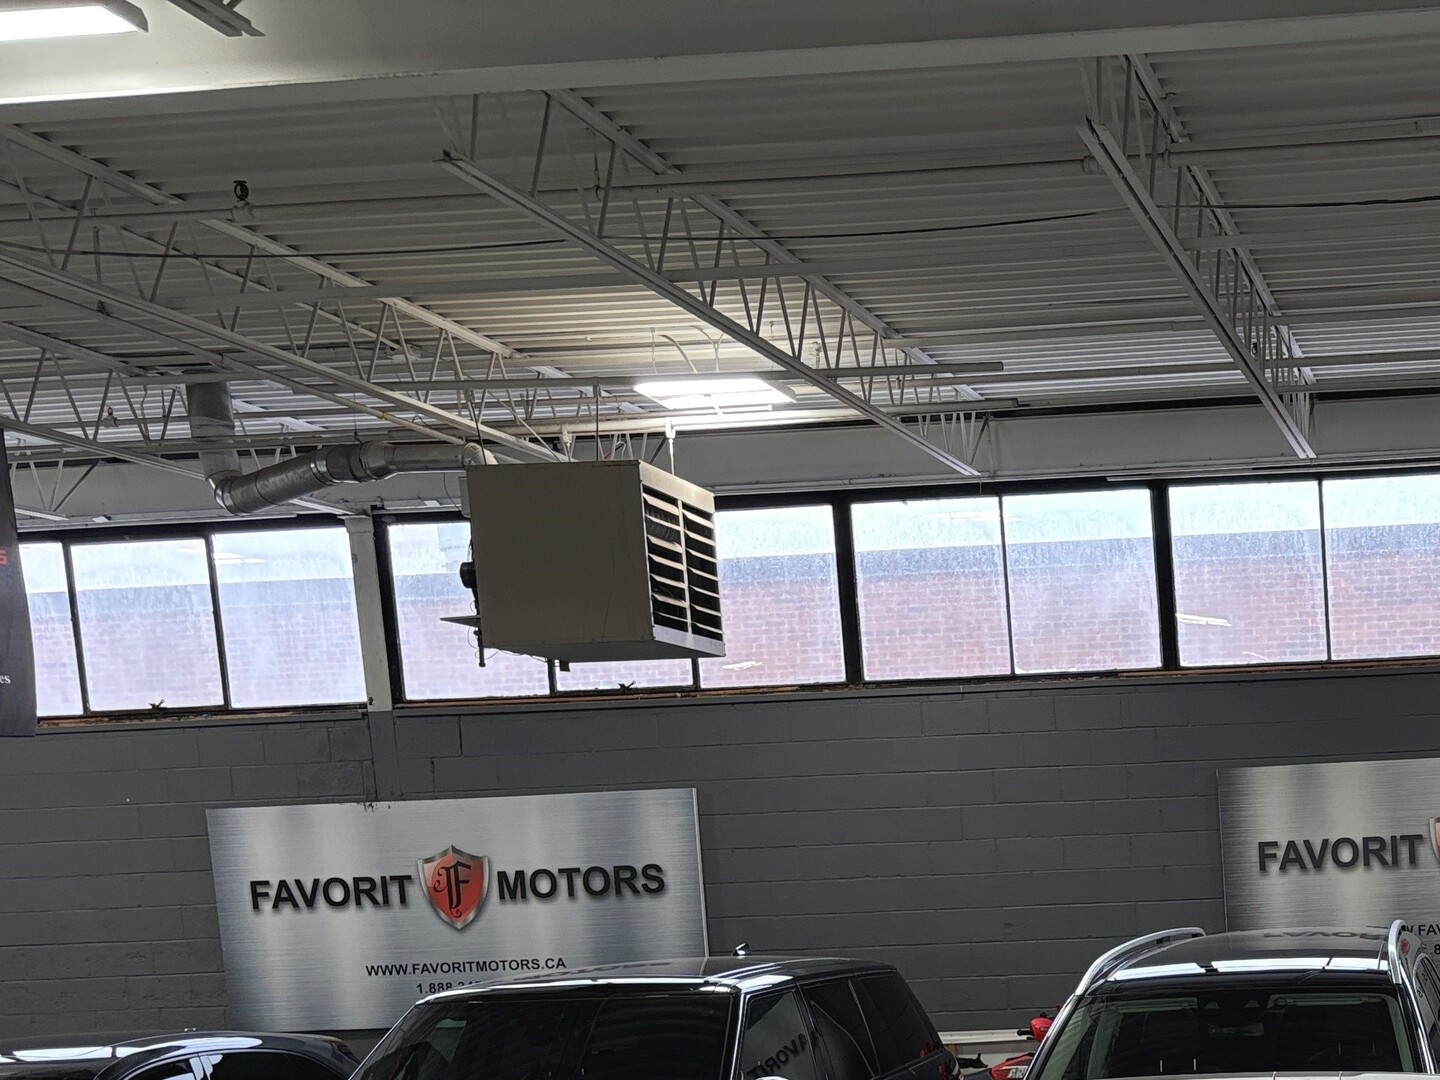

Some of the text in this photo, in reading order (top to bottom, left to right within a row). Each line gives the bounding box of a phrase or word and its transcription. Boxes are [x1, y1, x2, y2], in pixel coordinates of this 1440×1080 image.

[1258, 833, 1423, 872] FAVORIT
[250, 874, 412, 910] FAVORIT
[497, 863, 665, 901] MOTORS
[365, 957, 567, 977] WWW.FAVORITMOTORS.CA
